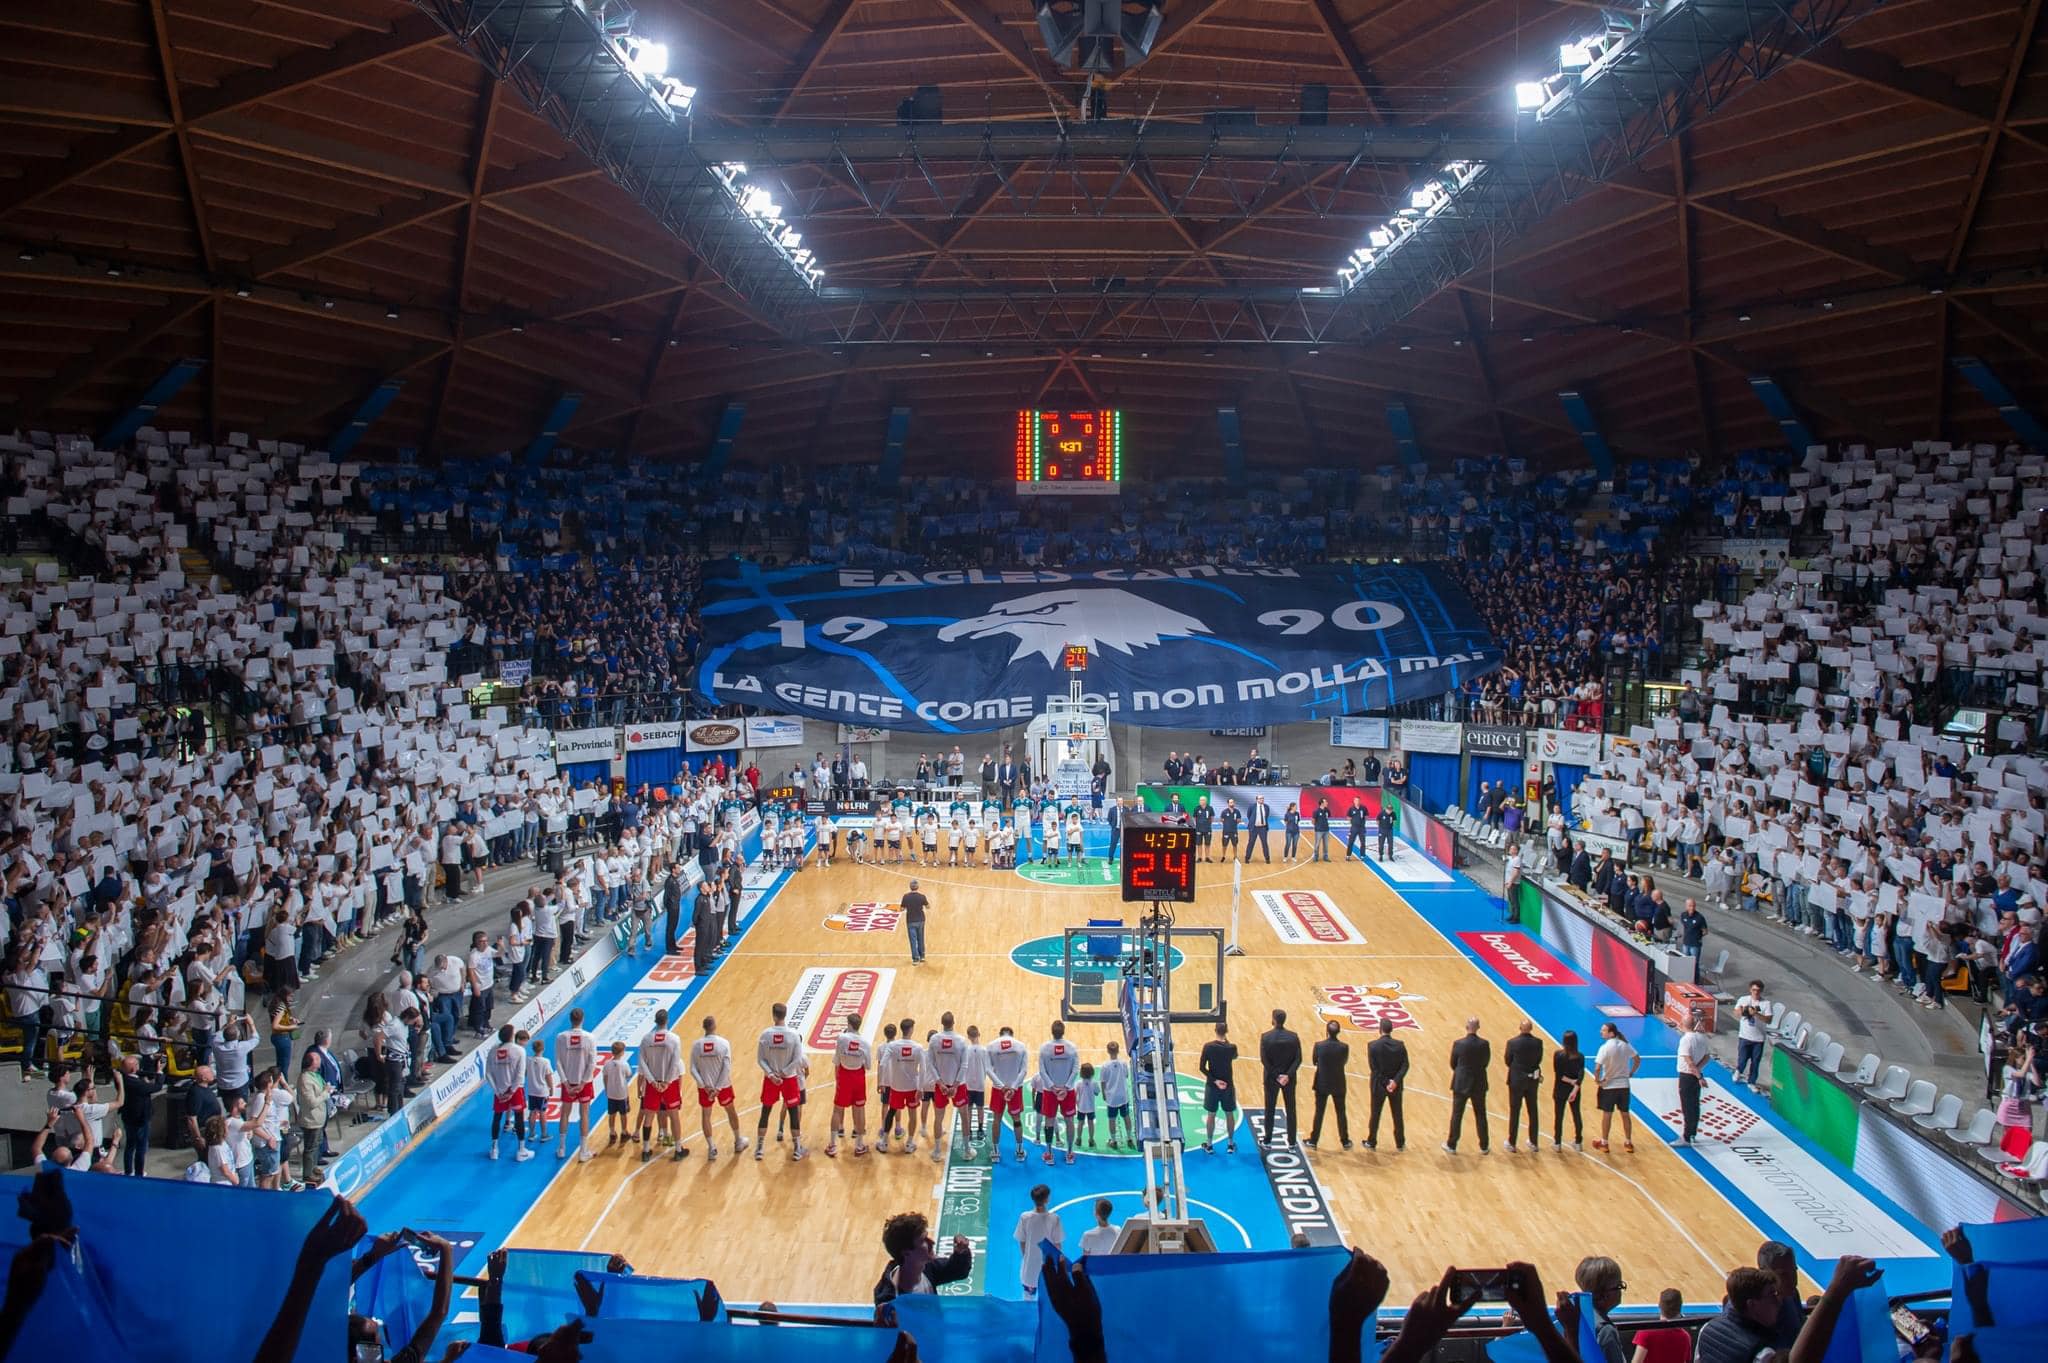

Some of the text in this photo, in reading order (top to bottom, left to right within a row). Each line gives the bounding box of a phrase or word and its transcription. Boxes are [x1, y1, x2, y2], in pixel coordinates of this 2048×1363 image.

[1051, 424, 1093, 434] 0 0
[1049, 465, 1093, 476] 0 0
[838, 568, 1073, 587] EAGLES
[1066, 654, 1086, 667] 24
[775, 682, 903, 718] GENTE
[915, 696, 1033, 721] COME
[1237, 658, 1388, 702] MOLLA
[643, 730, 680, 740] SEBACH
[558, 739, 613, 752] La Provincia
[1145, 832, 1190, 848] 4:37
[1132, 853, 1189, 887] 24
[846, 902, 877, 931] TOWN
[867, 912, 900, 931] FOX
[1480, 934, 1553, 982] bennet
[841, 973, 873, 990] OLD
[829, 990, 866, 1015] WILD
[1325, 986, 1380, 1030] TOWN
[1369, 1001, 1420, 1029] FOX
[947, 1166, 993, 1192] tabu
